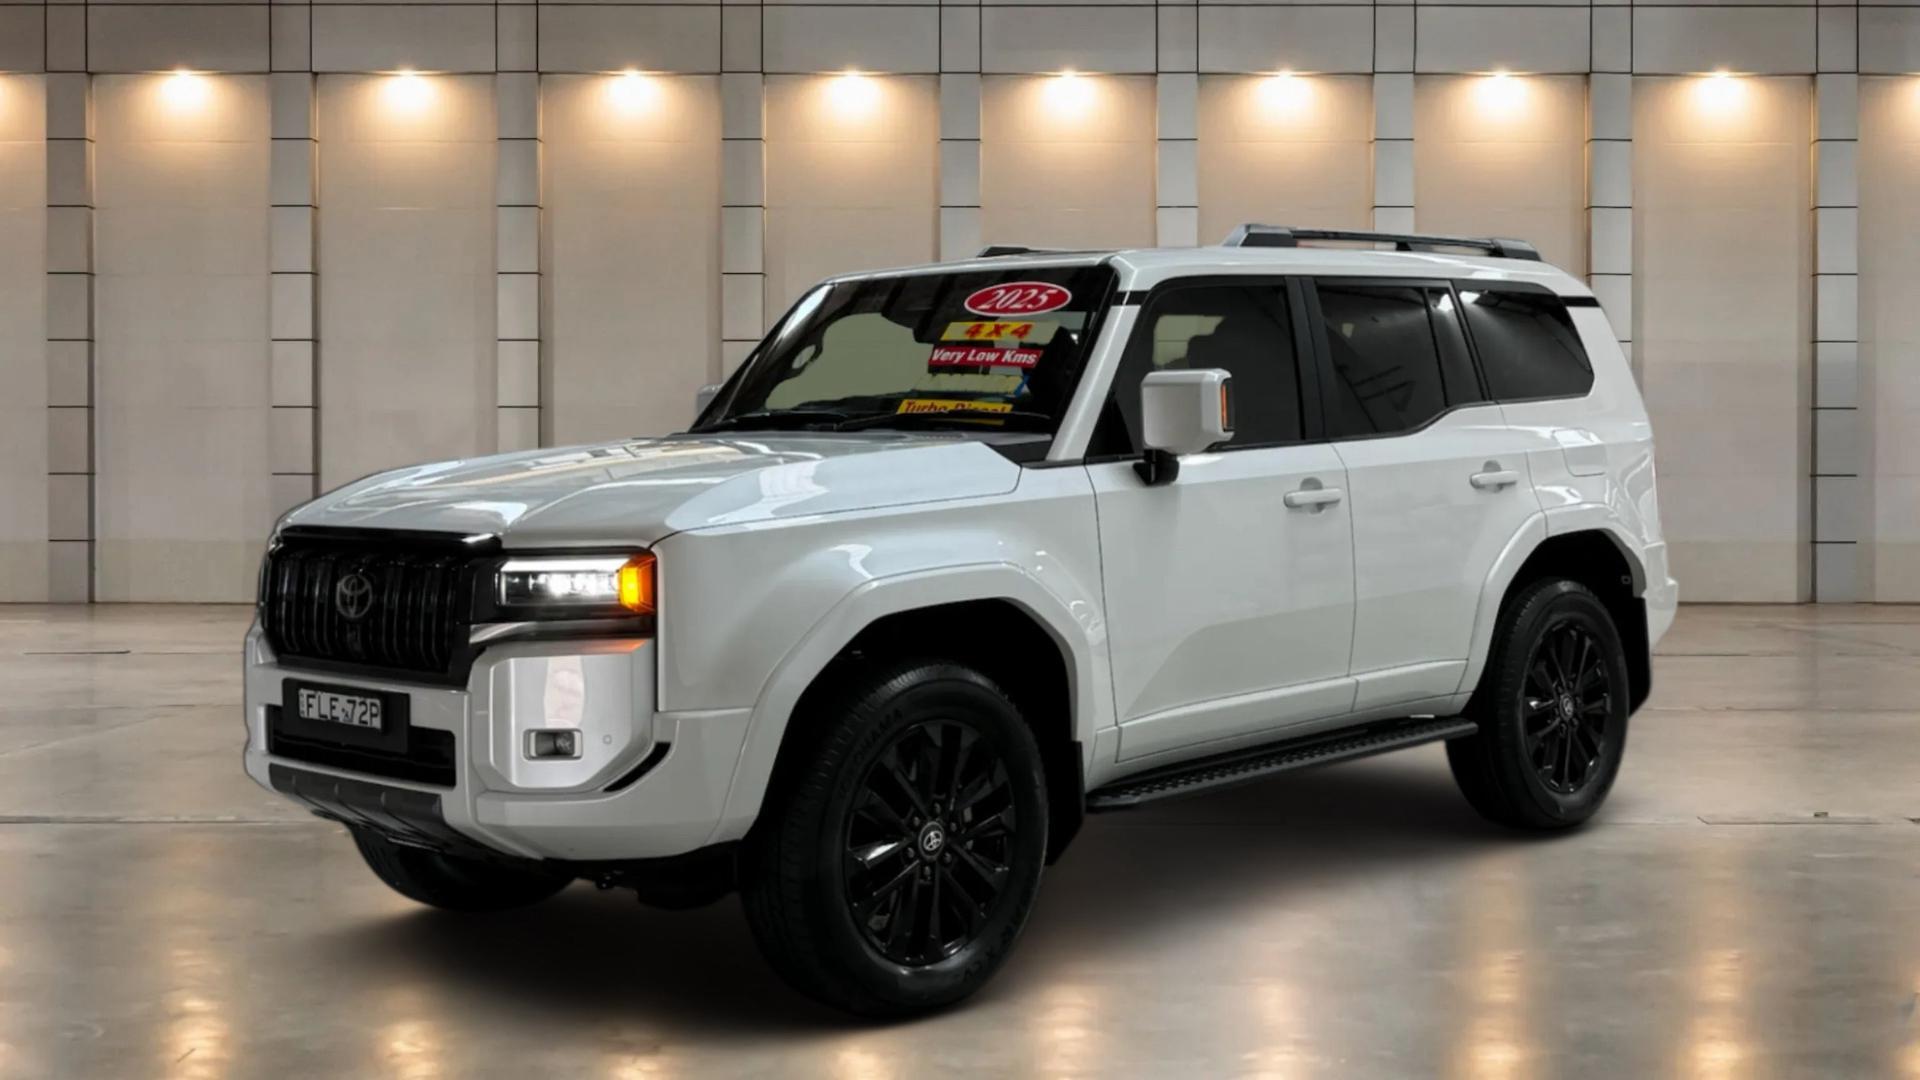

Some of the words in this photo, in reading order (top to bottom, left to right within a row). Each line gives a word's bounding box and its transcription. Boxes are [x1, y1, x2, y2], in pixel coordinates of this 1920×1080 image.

[976, 288, 1058, 310] 2025
[931, 348, 964, 364] Very
[968, 348, 1000, 362] Low
[1002, 349, 1038, 365] Kms
